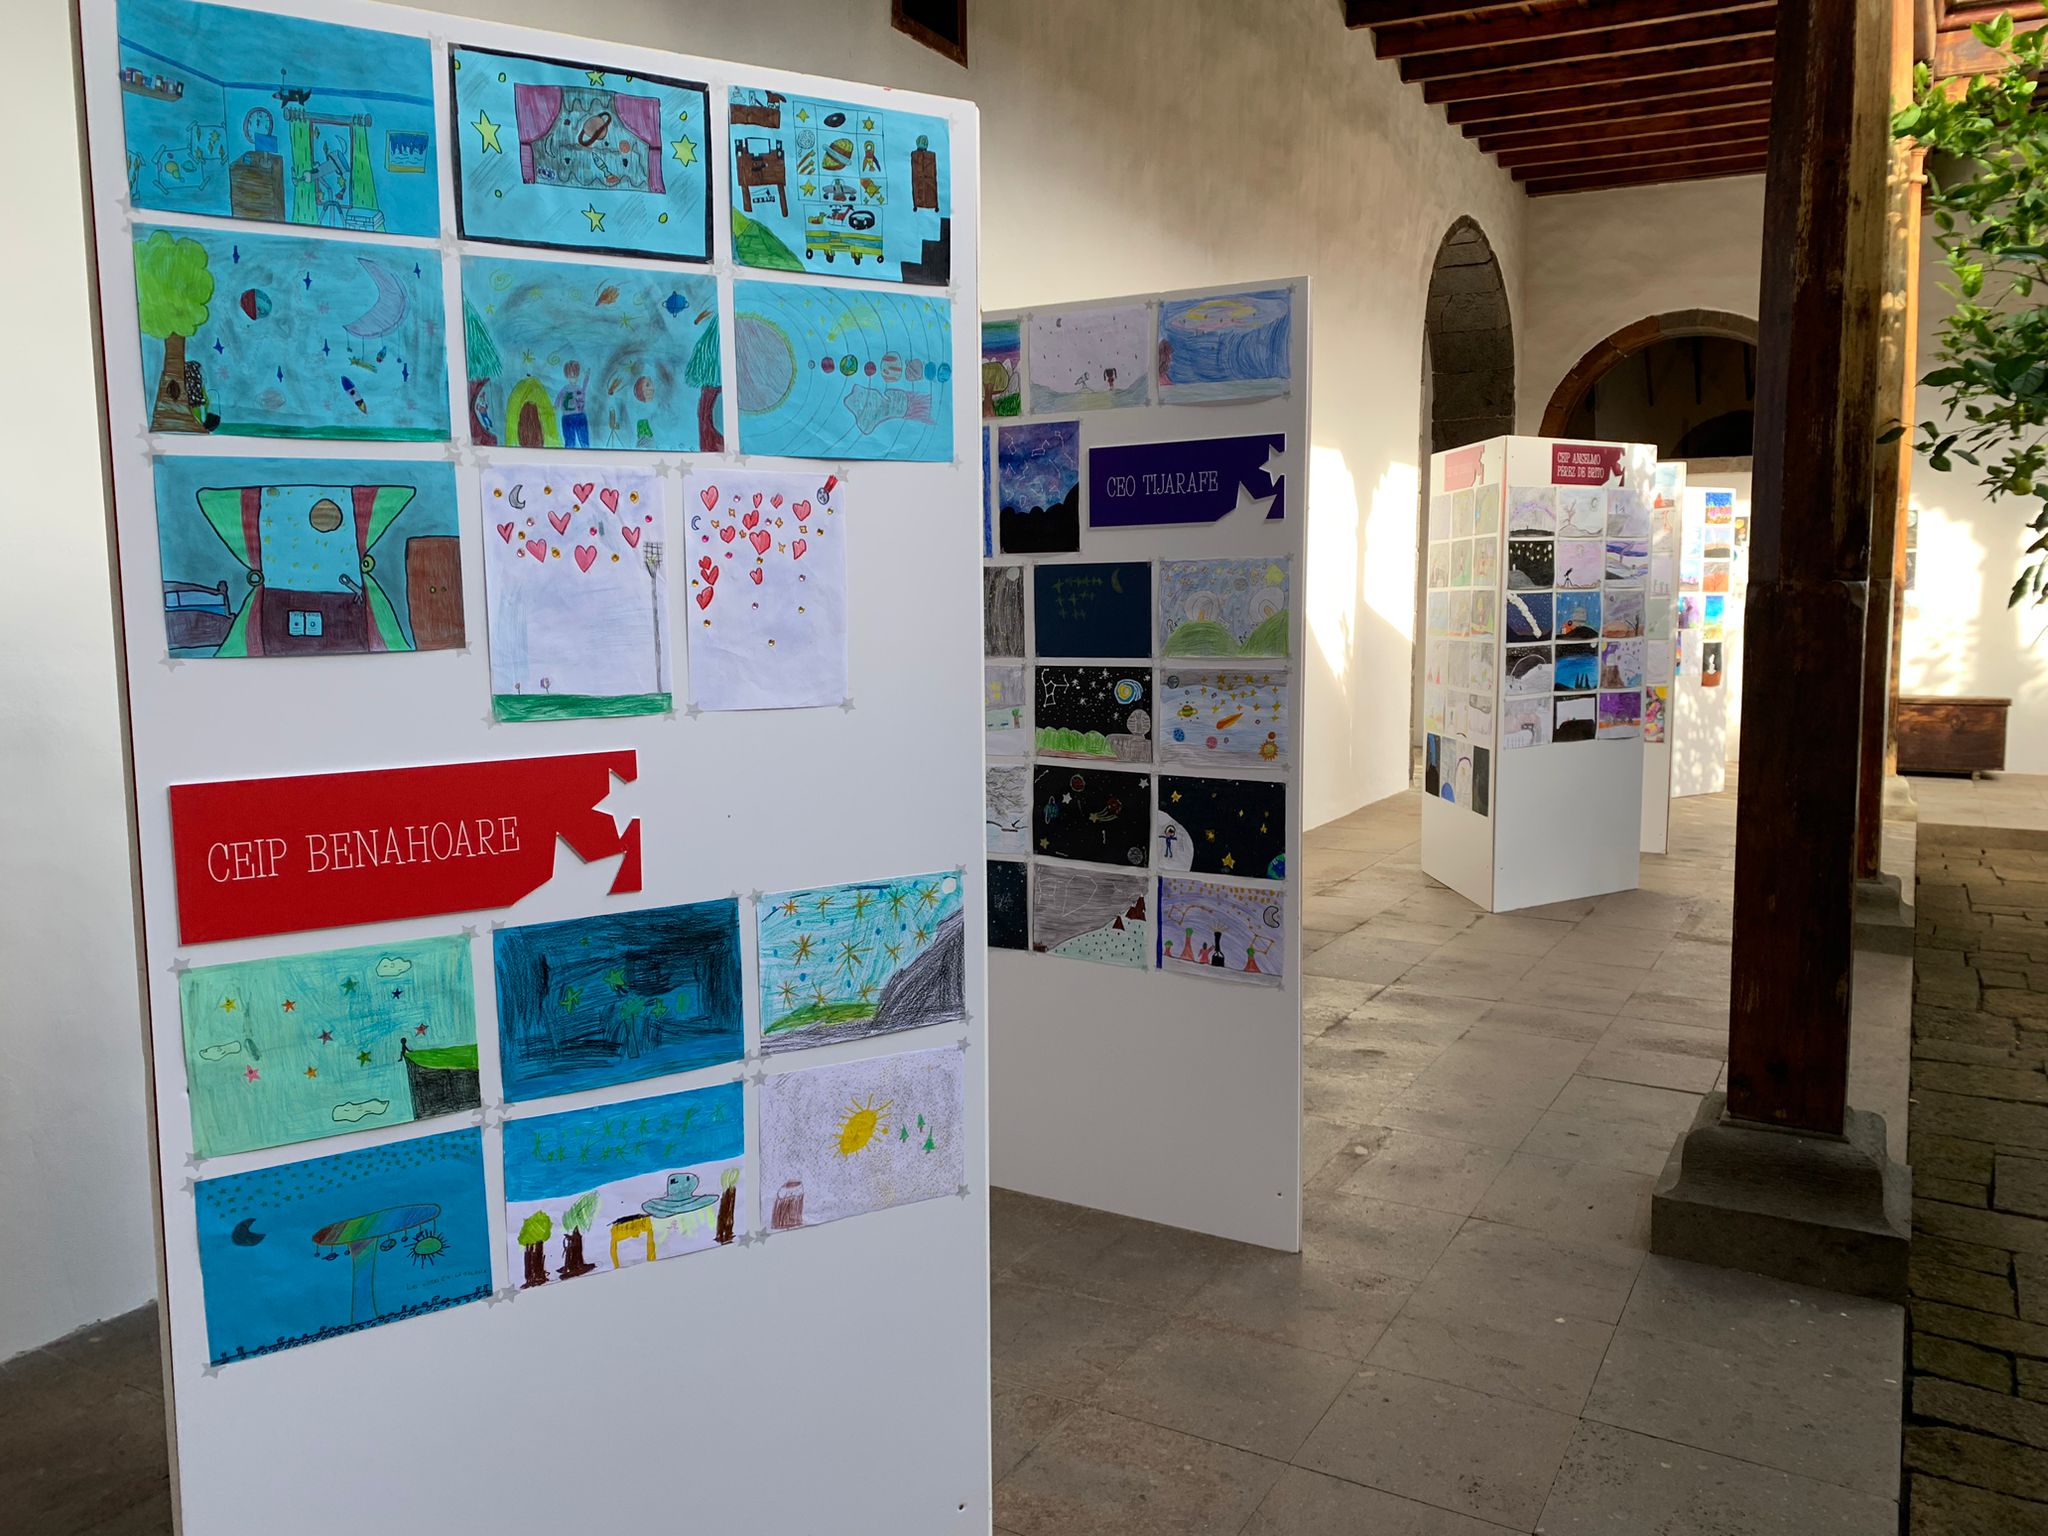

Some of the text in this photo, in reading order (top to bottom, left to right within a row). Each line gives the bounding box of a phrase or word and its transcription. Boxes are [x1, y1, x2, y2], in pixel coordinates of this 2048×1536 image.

[1572, 452, 1602, 465] ANSELMO
[1577, 466, 1587, 478] DE
[1587, 466, 1605, 479] BRITO
[1106, 470, 1219, 498] CEO TIJARAFE
[207, 816, 520, 883] CEIP BENAHOARE
